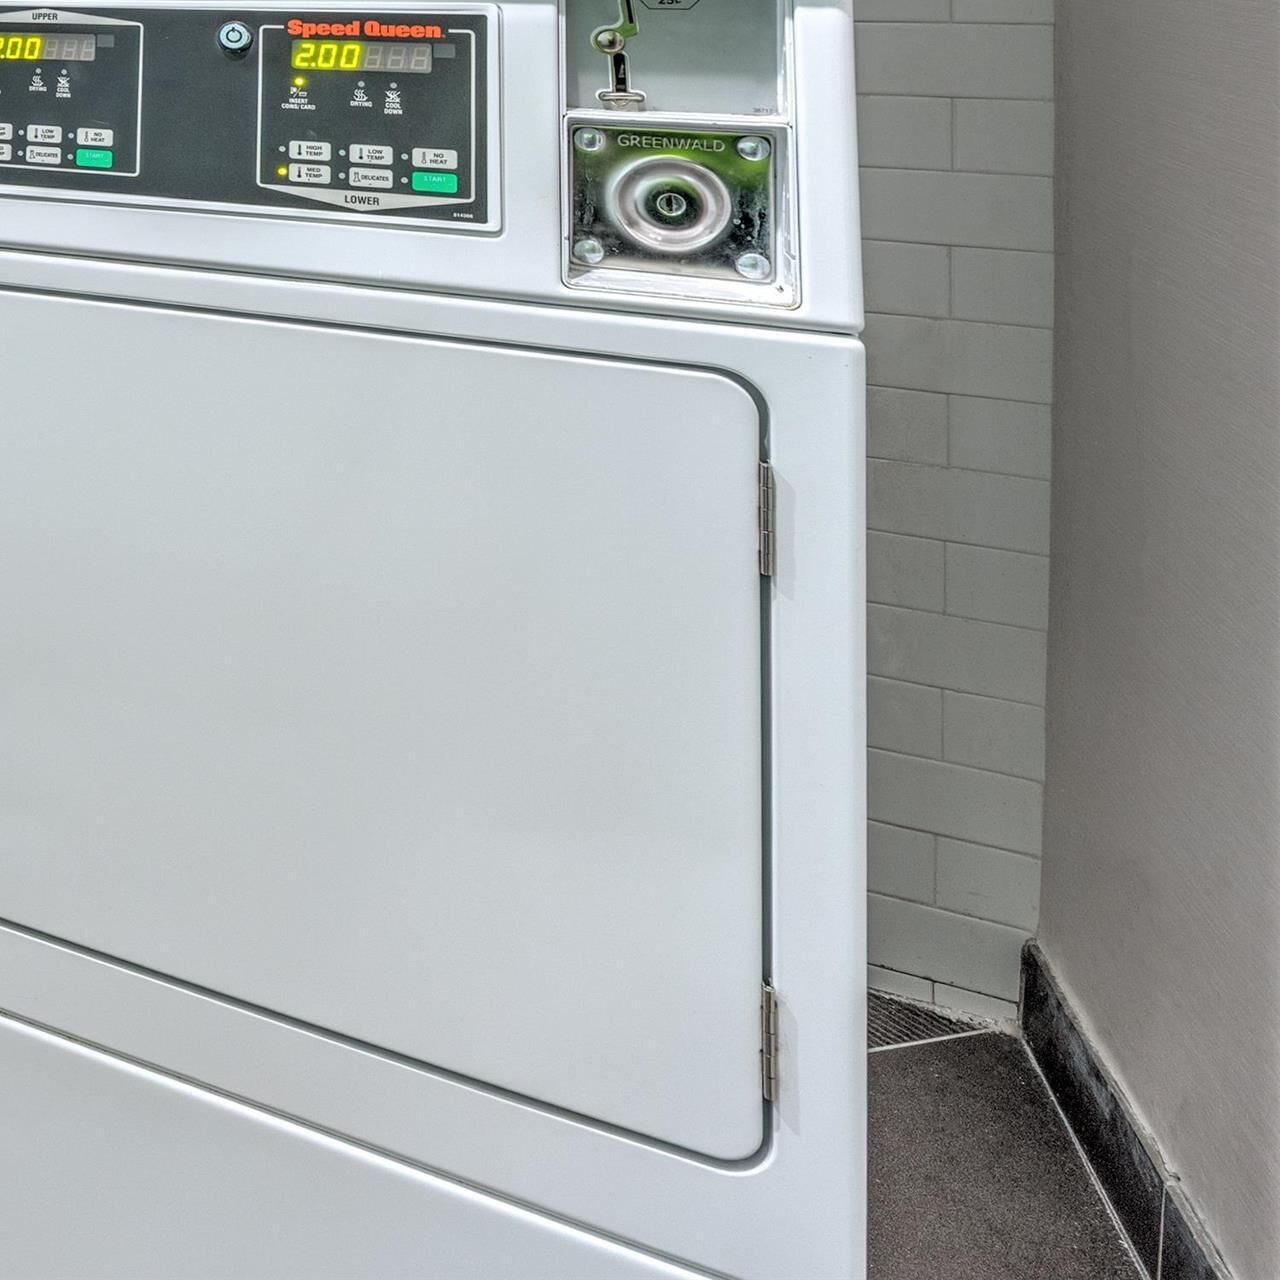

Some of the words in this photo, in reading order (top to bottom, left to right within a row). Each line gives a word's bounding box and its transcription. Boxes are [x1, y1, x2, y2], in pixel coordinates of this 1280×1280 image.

[32, 12, 58, 21] UPPER
[287, 19, 360, 38] Speed
[294, 43, 361, 68] 2.00
[617, 134, 726, 152] GREENWALD
[361, 174, 390, 182] DELICATES
[344, 194, 380, 206] LOWER
